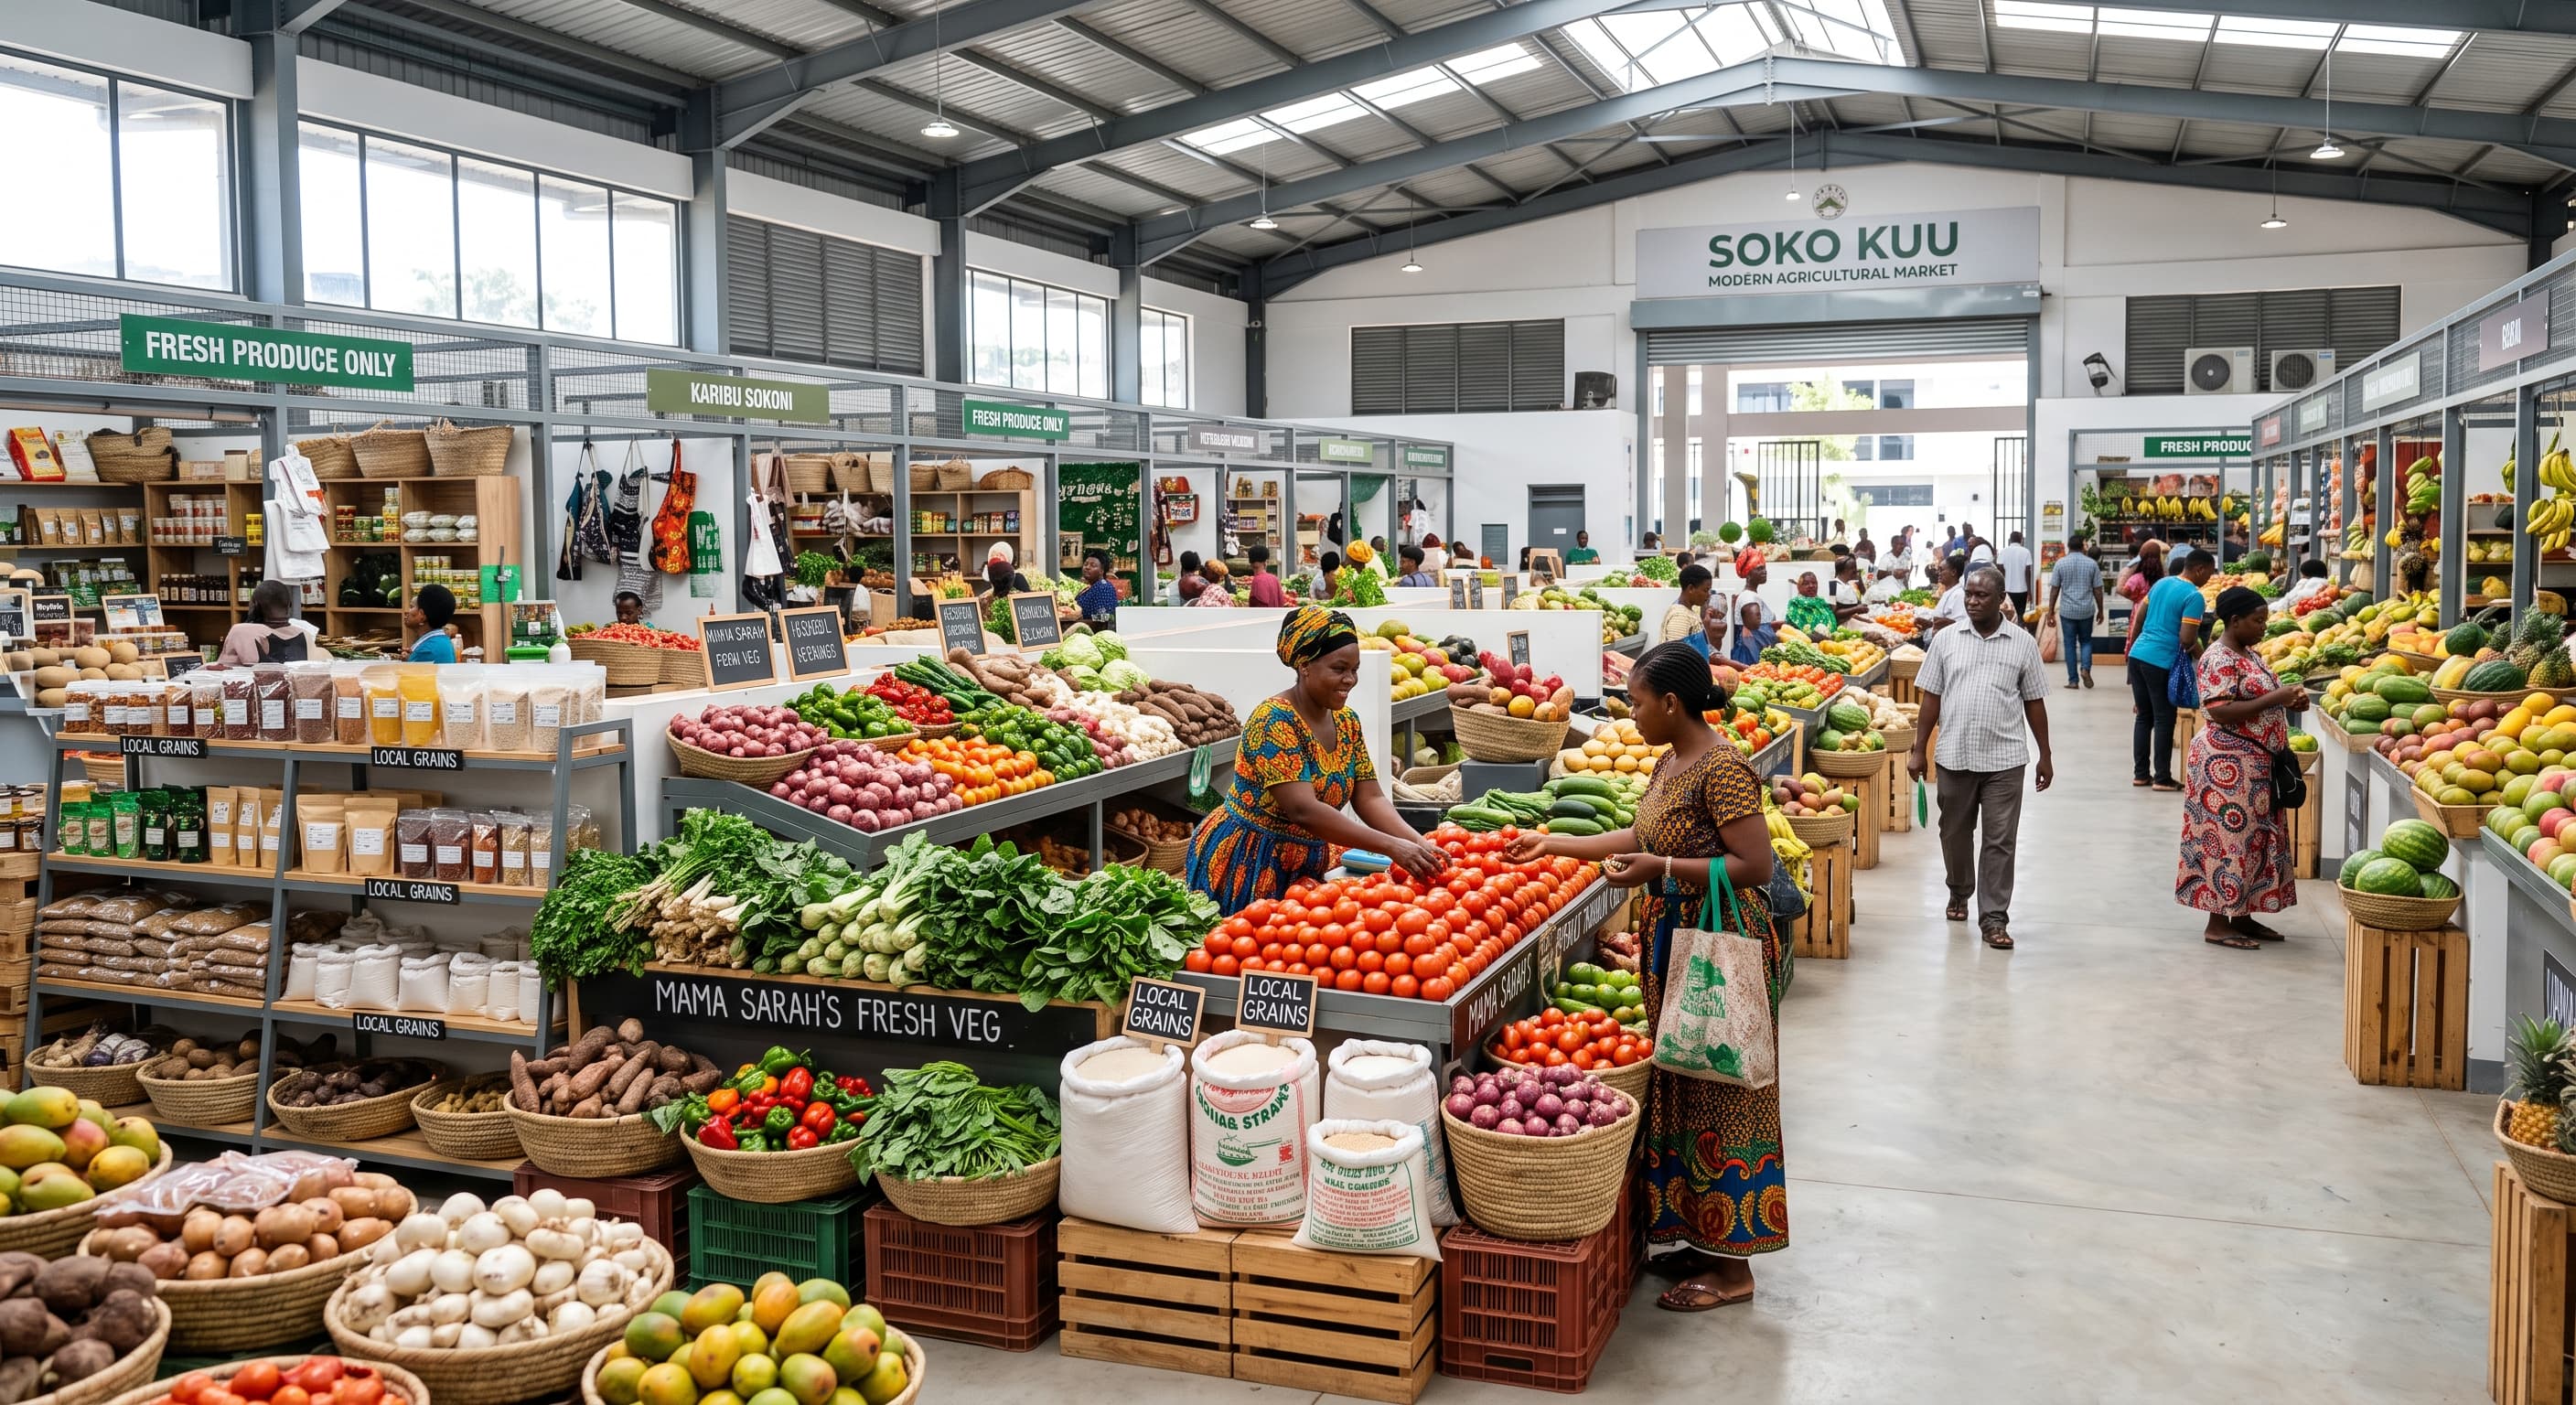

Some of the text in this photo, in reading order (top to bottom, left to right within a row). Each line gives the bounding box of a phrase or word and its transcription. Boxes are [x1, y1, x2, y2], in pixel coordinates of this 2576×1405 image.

[1709, 221, 1959, 268] SOKO KUU
[1776, 267, 1890, 284] AGRICULTURAL
[1894, 263, 1959, 279] MARKET
[145, 330, 396, 378] FRESH PRODUCE ONLY
[691, 381, 793, 411] KARIBU SOKONI
[972, 409, 1064, 433] FRESH PRODUCE ONLY
[2161, 441, 2200, 453] FRESH
[123, 738, 199, 756] LOCAL GRAINS
[374, 749, 456, 768] LOCAL GRAINS
[368, 881, 452, 901] LOCAL GRAINS
[1135, 983, 1188, 1011] LOCAL
[1248, 976, 1303, 1001] LOCAL
[655, 980, 728, 1018] MAMA
[741, 987, 842, 1029] SARAH'S
[858, 998, 936, 1037] FRESH
[1130, 1006, 1192, 1037] GRAINS
[1243, 999, 1308, 1026] GRAINS
[1468, 983, 1497, 1041] MAMA
[357, 1016, 439, 1037] LOCAL GRAINS
